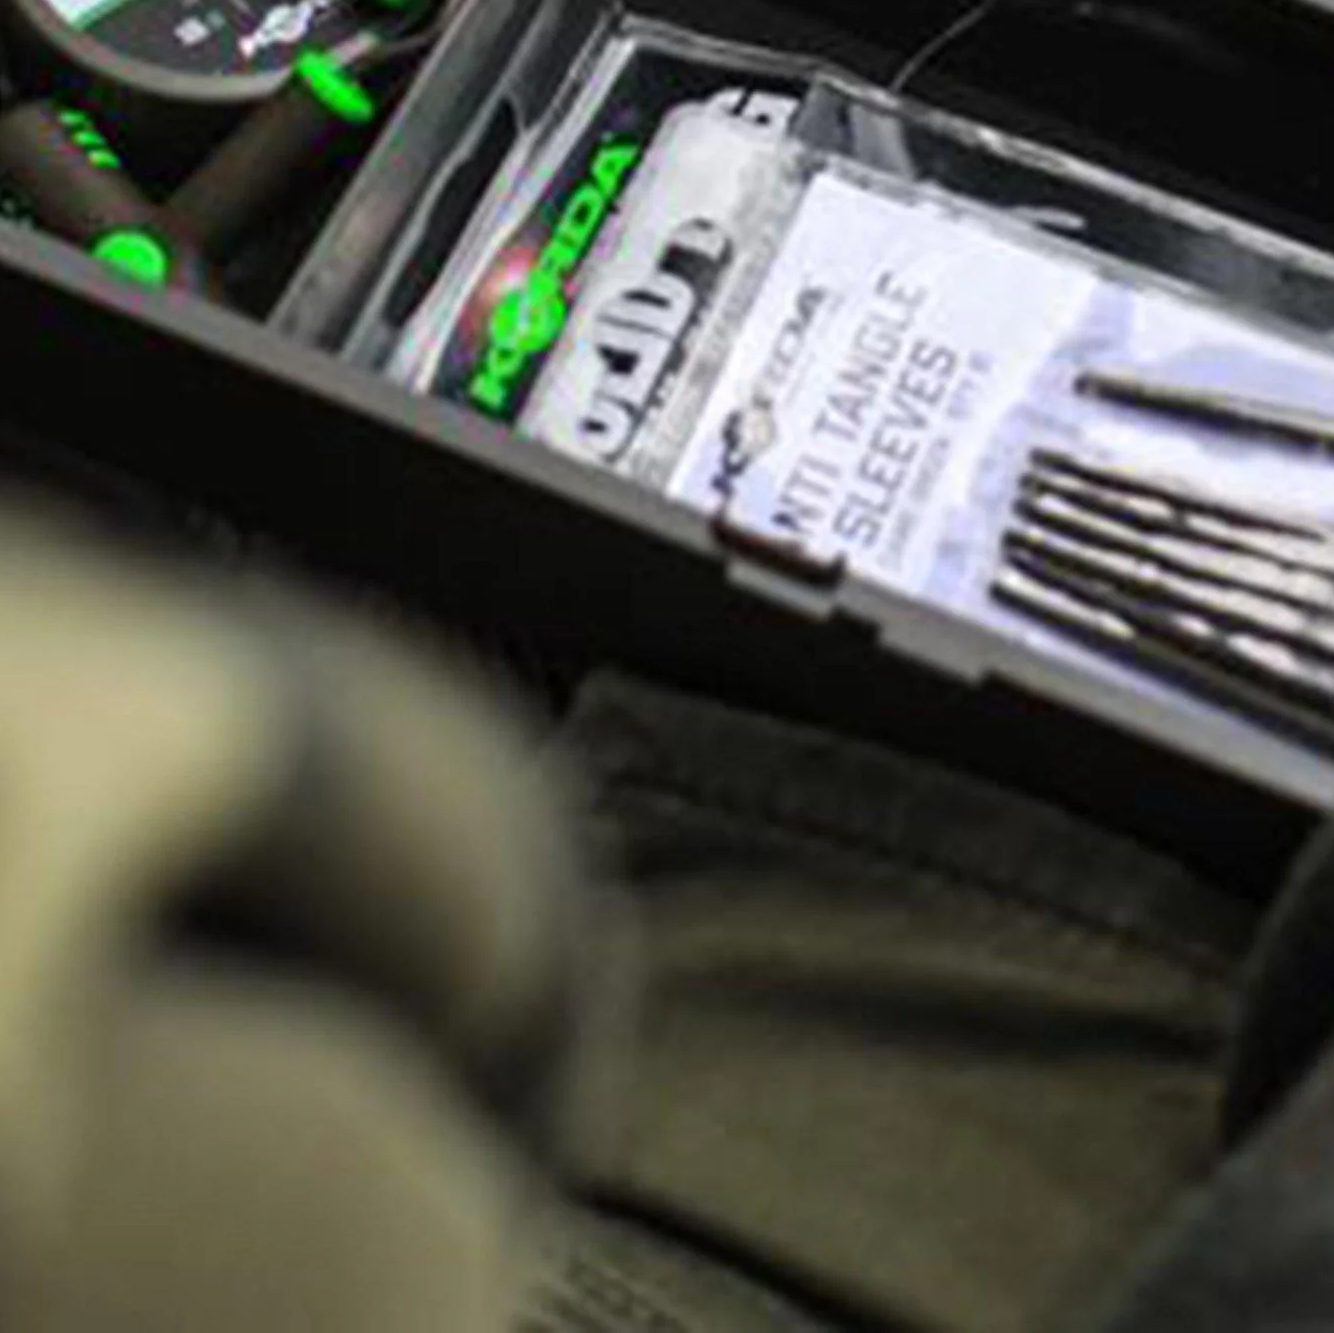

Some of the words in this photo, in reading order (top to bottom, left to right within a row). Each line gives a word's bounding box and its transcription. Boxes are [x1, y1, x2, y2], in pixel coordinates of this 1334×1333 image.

[470, 140, 640, 410] KORDA
[769, 448, 842, 536] NTI
[809, 270, 928, 445] TANGLE
[830, 339, 960, 547] SLEEVES
